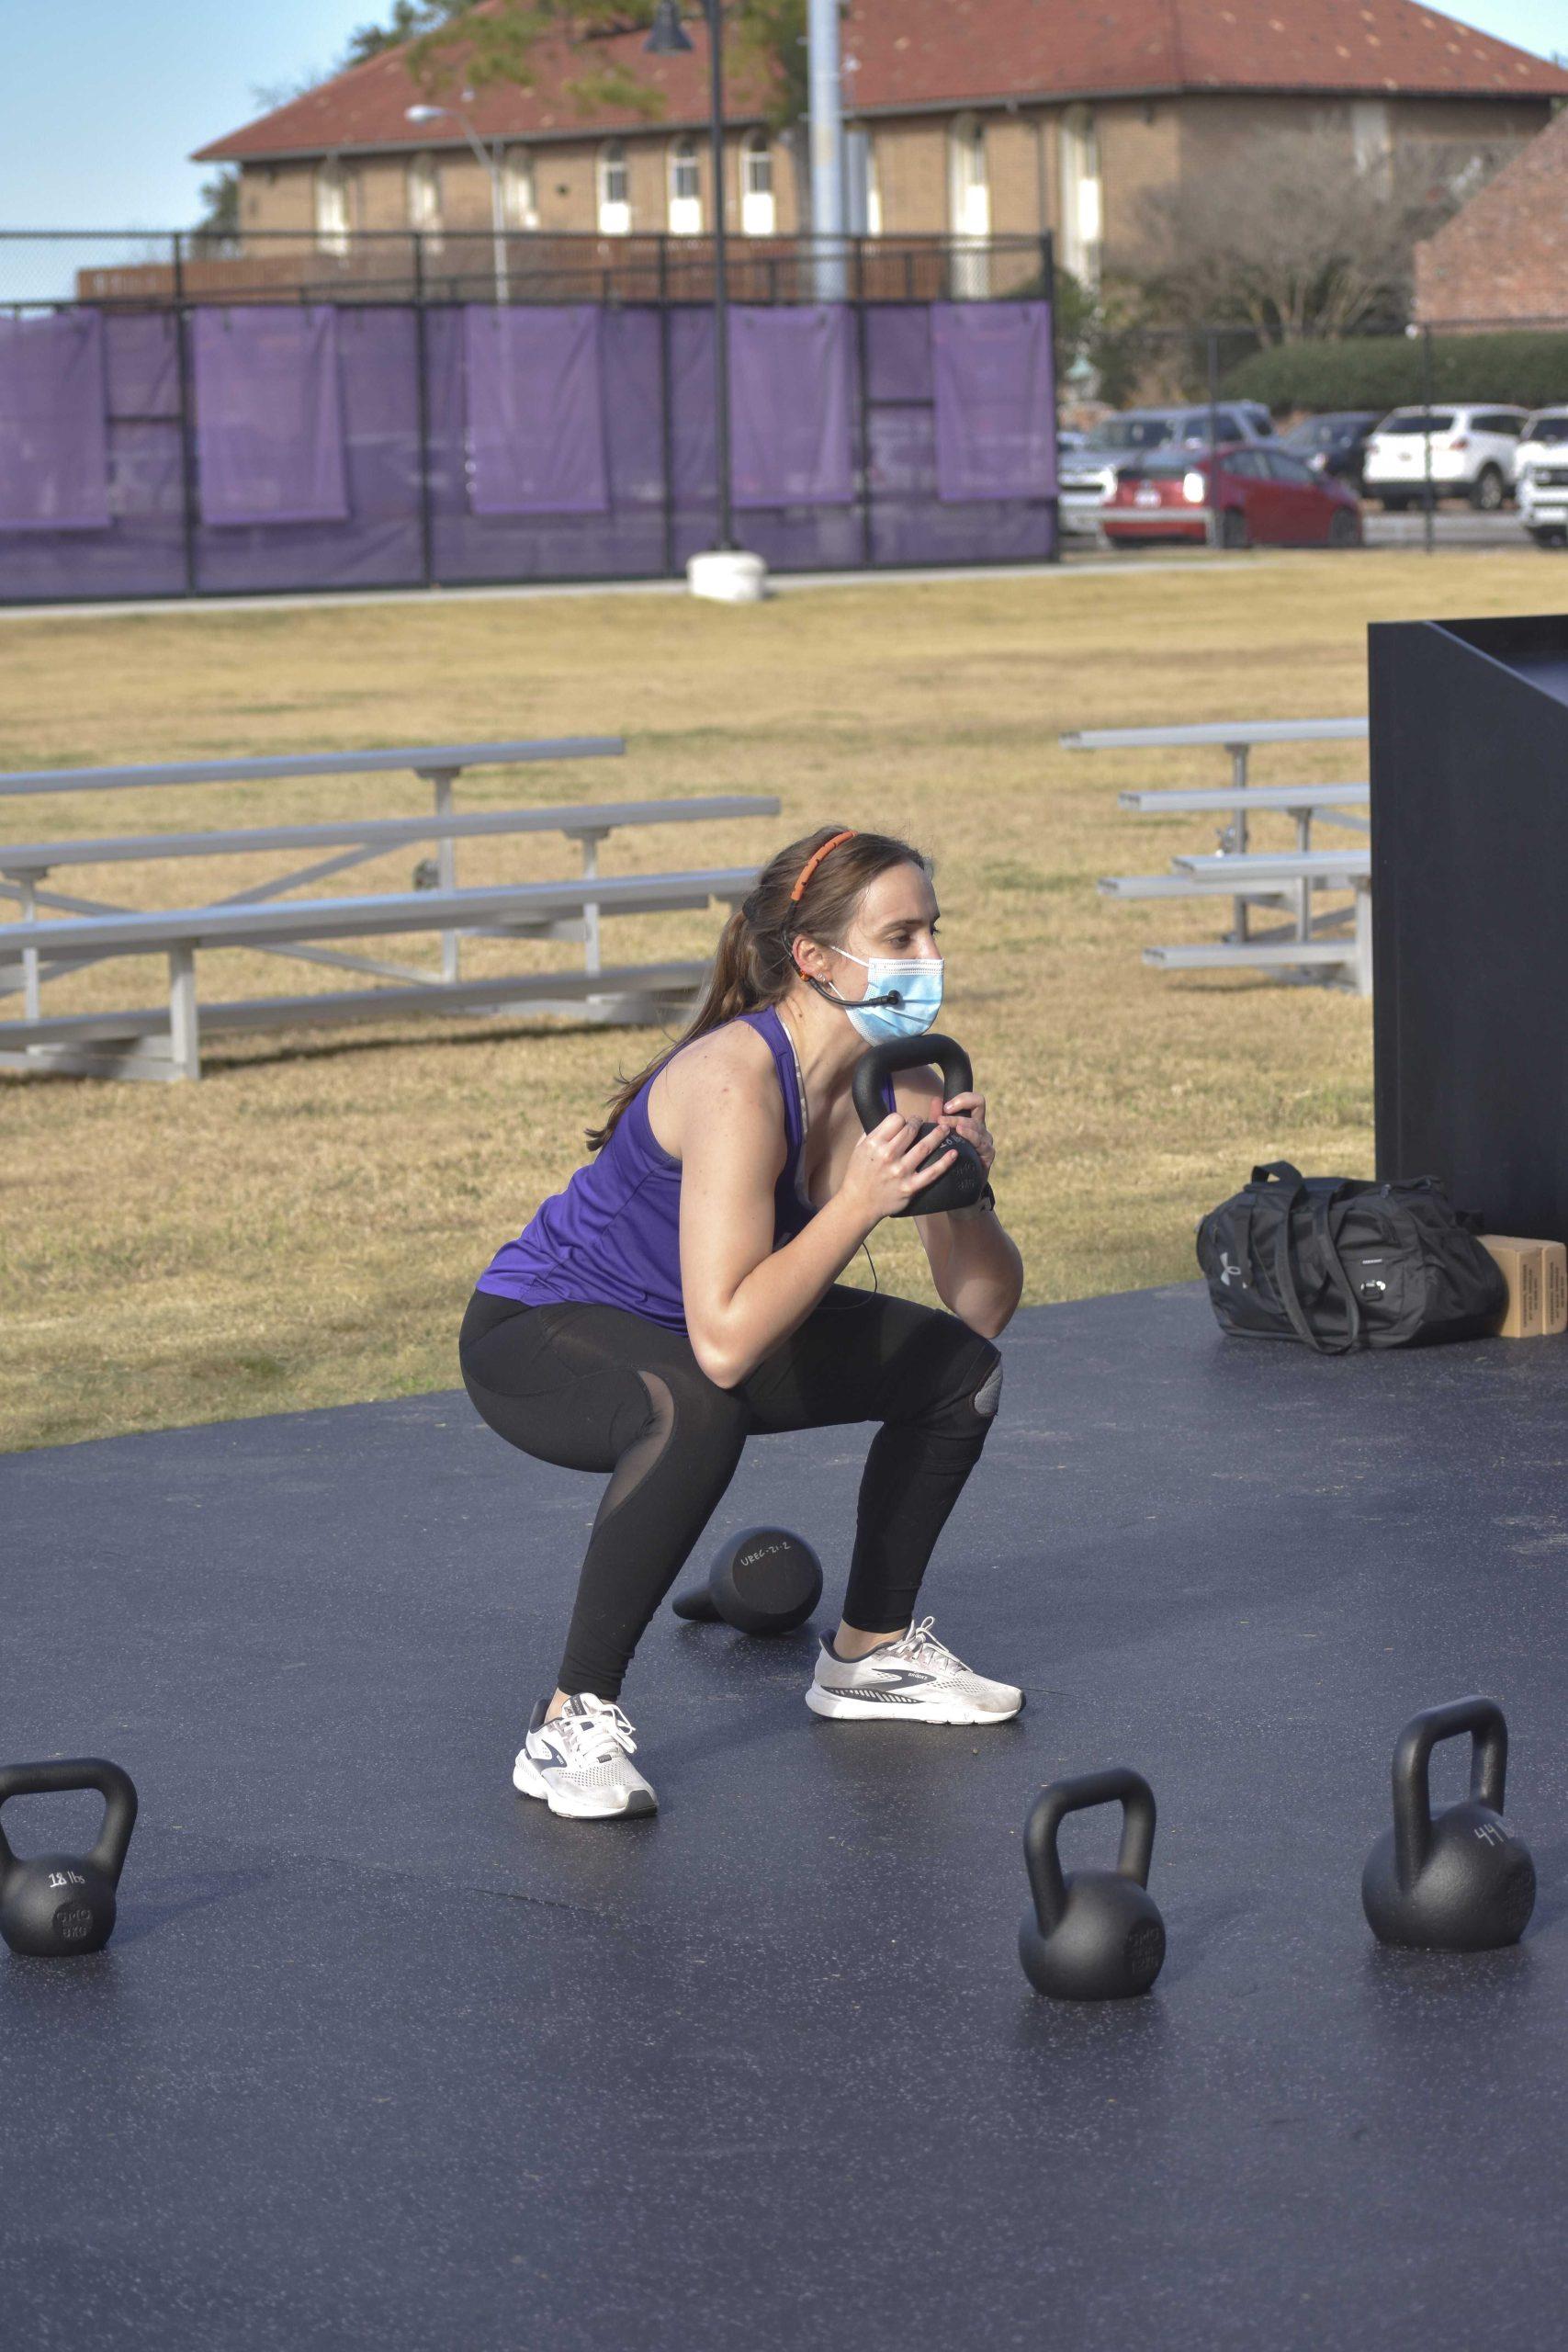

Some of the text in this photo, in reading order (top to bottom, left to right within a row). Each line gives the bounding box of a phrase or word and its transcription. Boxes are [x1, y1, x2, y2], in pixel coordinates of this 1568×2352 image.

[1473, 1824, 1505, 1846] 44
[49, 1871, 85, 1888] 18 lbs
